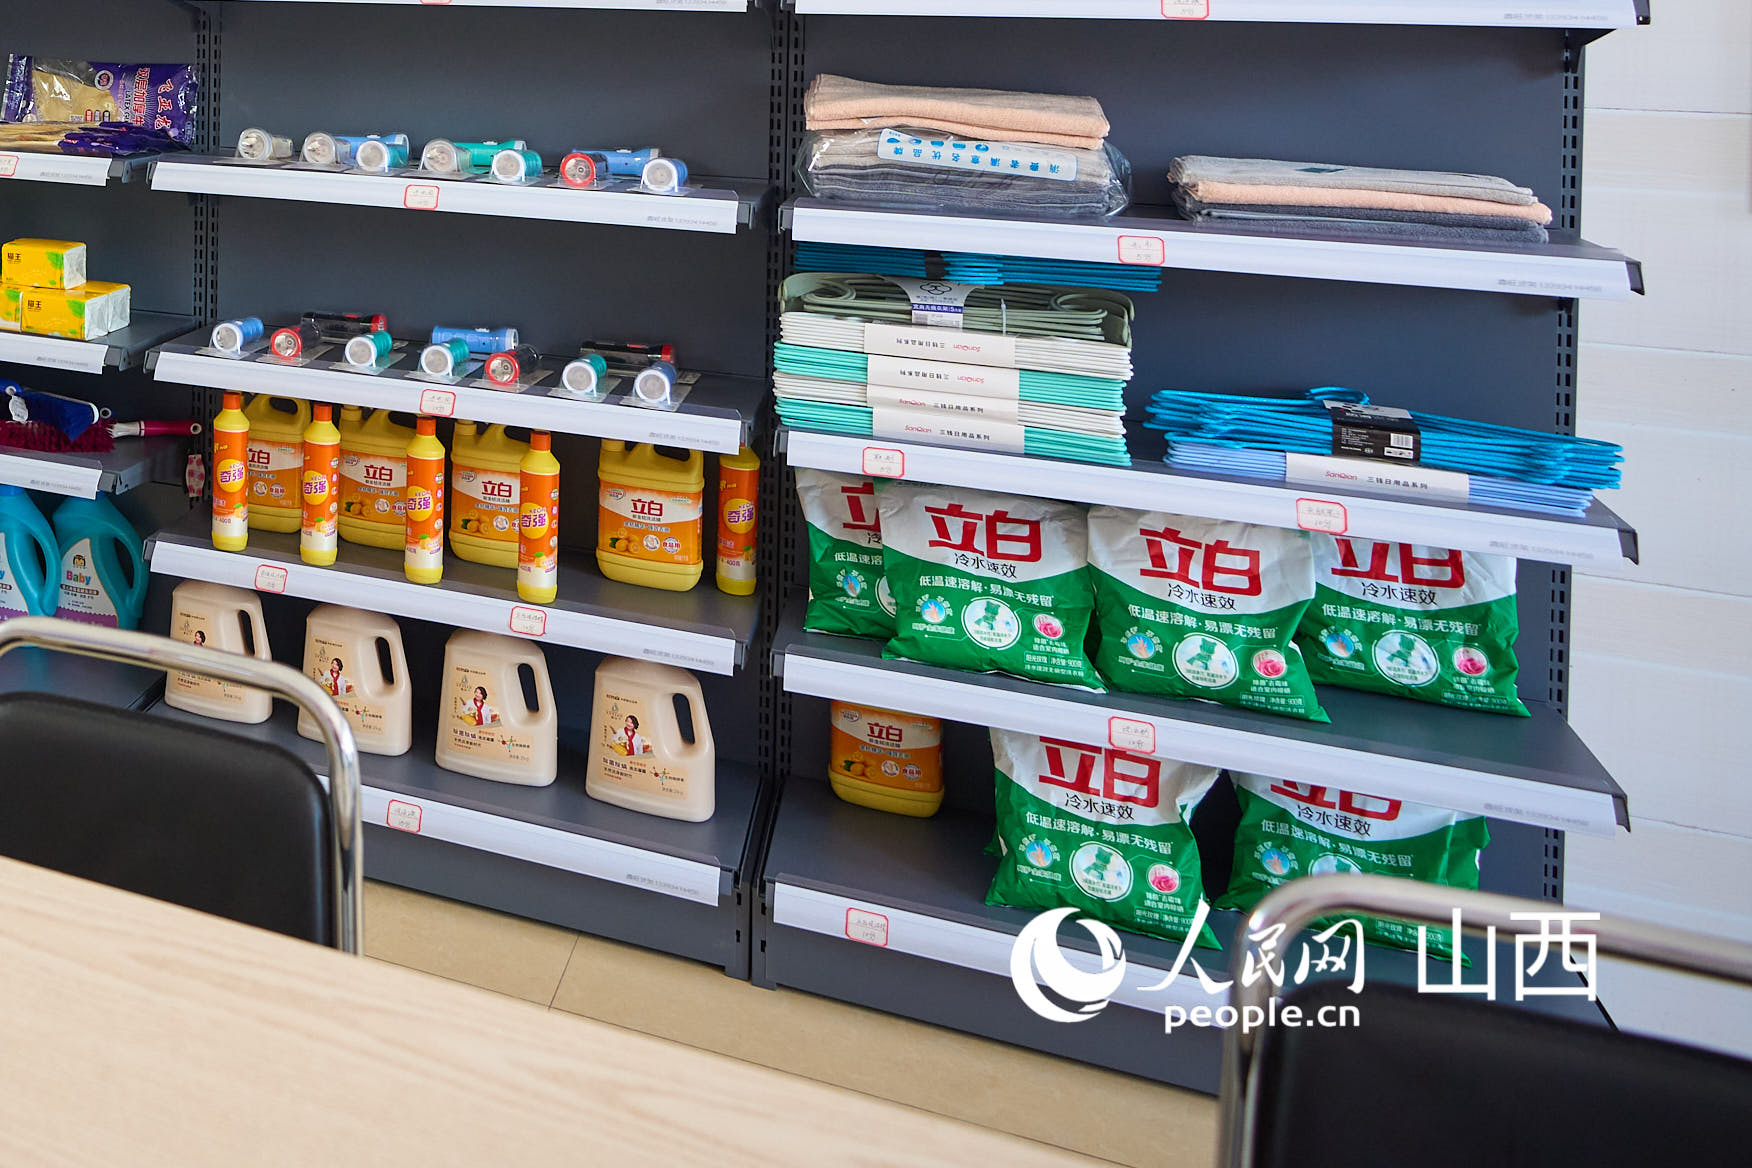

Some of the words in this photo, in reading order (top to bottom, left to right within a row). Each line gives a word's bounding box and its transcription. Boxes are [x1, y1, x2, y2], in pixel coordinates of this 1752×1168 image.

[153, 79, 174, 130] 飞亚龙
[893, 145, 1060, 174] 消费者满意名优品牌
[898, 398, 927, 408] SanQian
[904, 424, 933, 434] SanQian
[219, 467, 244, 483] 奇强
[364, 464, 393, 482] 立白
[1325, 470, 1358, 481] SanQian
[303, 478, 327, 495] 奇强
[481, 480, 512, 498] 立白
[406, 495, 431, 511] 奇强
[630, 498, 663, 516] 立白
[520, 511, 547, 527] 奇强
[727, 507, 754, 524] 奇强
[924, 503, 1042, 563] 立白
[955, 553, 1018, 579] 冷水速效
[1139, 527, 1262, 597] 立白
[1330, 534, 1465, 589] 立白
[66, 570, 91, 588] Baby
[1168, 583, 1237, 610] 冷水速效
[1361, 582, 1438, 606] 冷水速效
[867, 721, 903, 743] 立白
[1038, 736, 1161, 808] 立白
[1064, 792, 1135, 821] 冷水速效
[1296, 804, 1373, 838] 冷水速效
